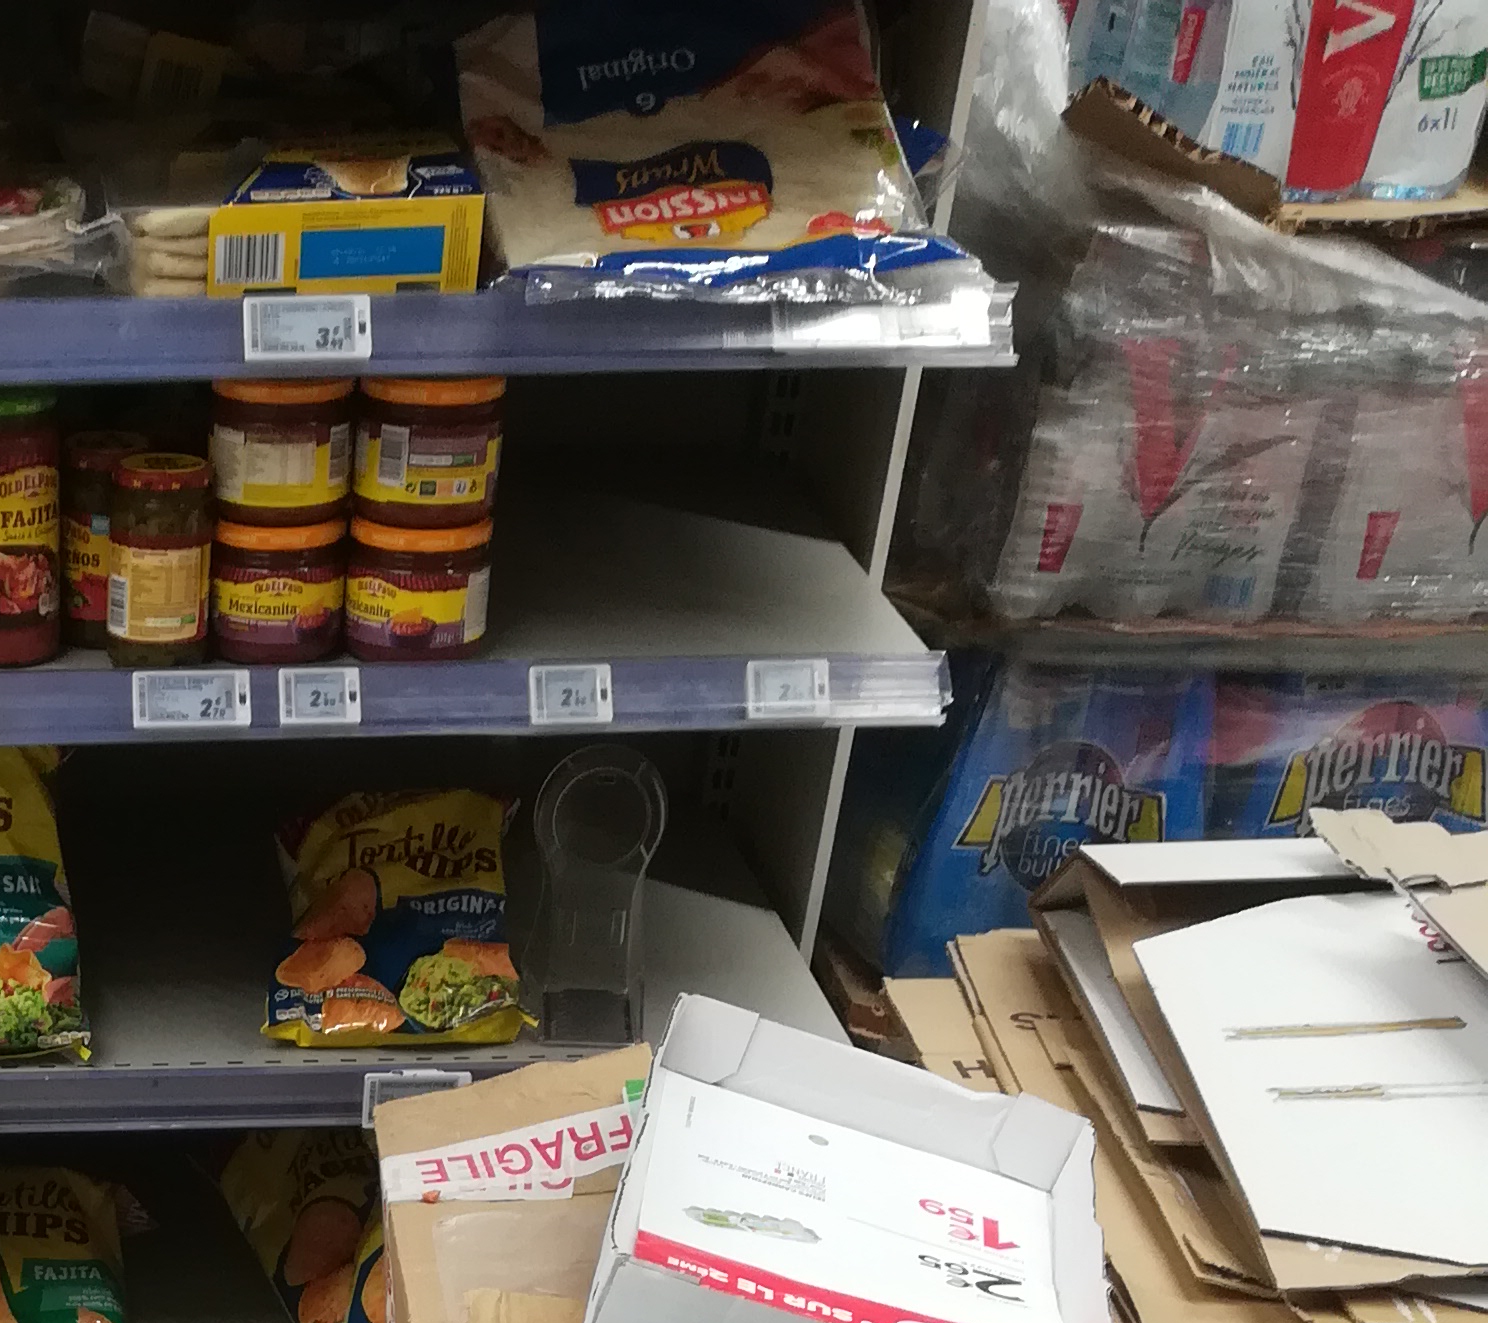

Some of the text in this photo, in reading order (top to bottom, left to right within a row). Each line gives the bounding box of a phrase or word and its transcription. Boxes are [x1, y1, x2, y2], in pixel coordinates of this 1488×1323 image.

[576, 47, 697, 92] Original
[616, 149, 725, 195] Wraps
[415, 1112, 634, 1185] FRAGILE
[33, 1264, 102, 1283] FAJITA
[736, 1277, 774, 1301] LE
[783, 1293, 852, 1323] SUR
